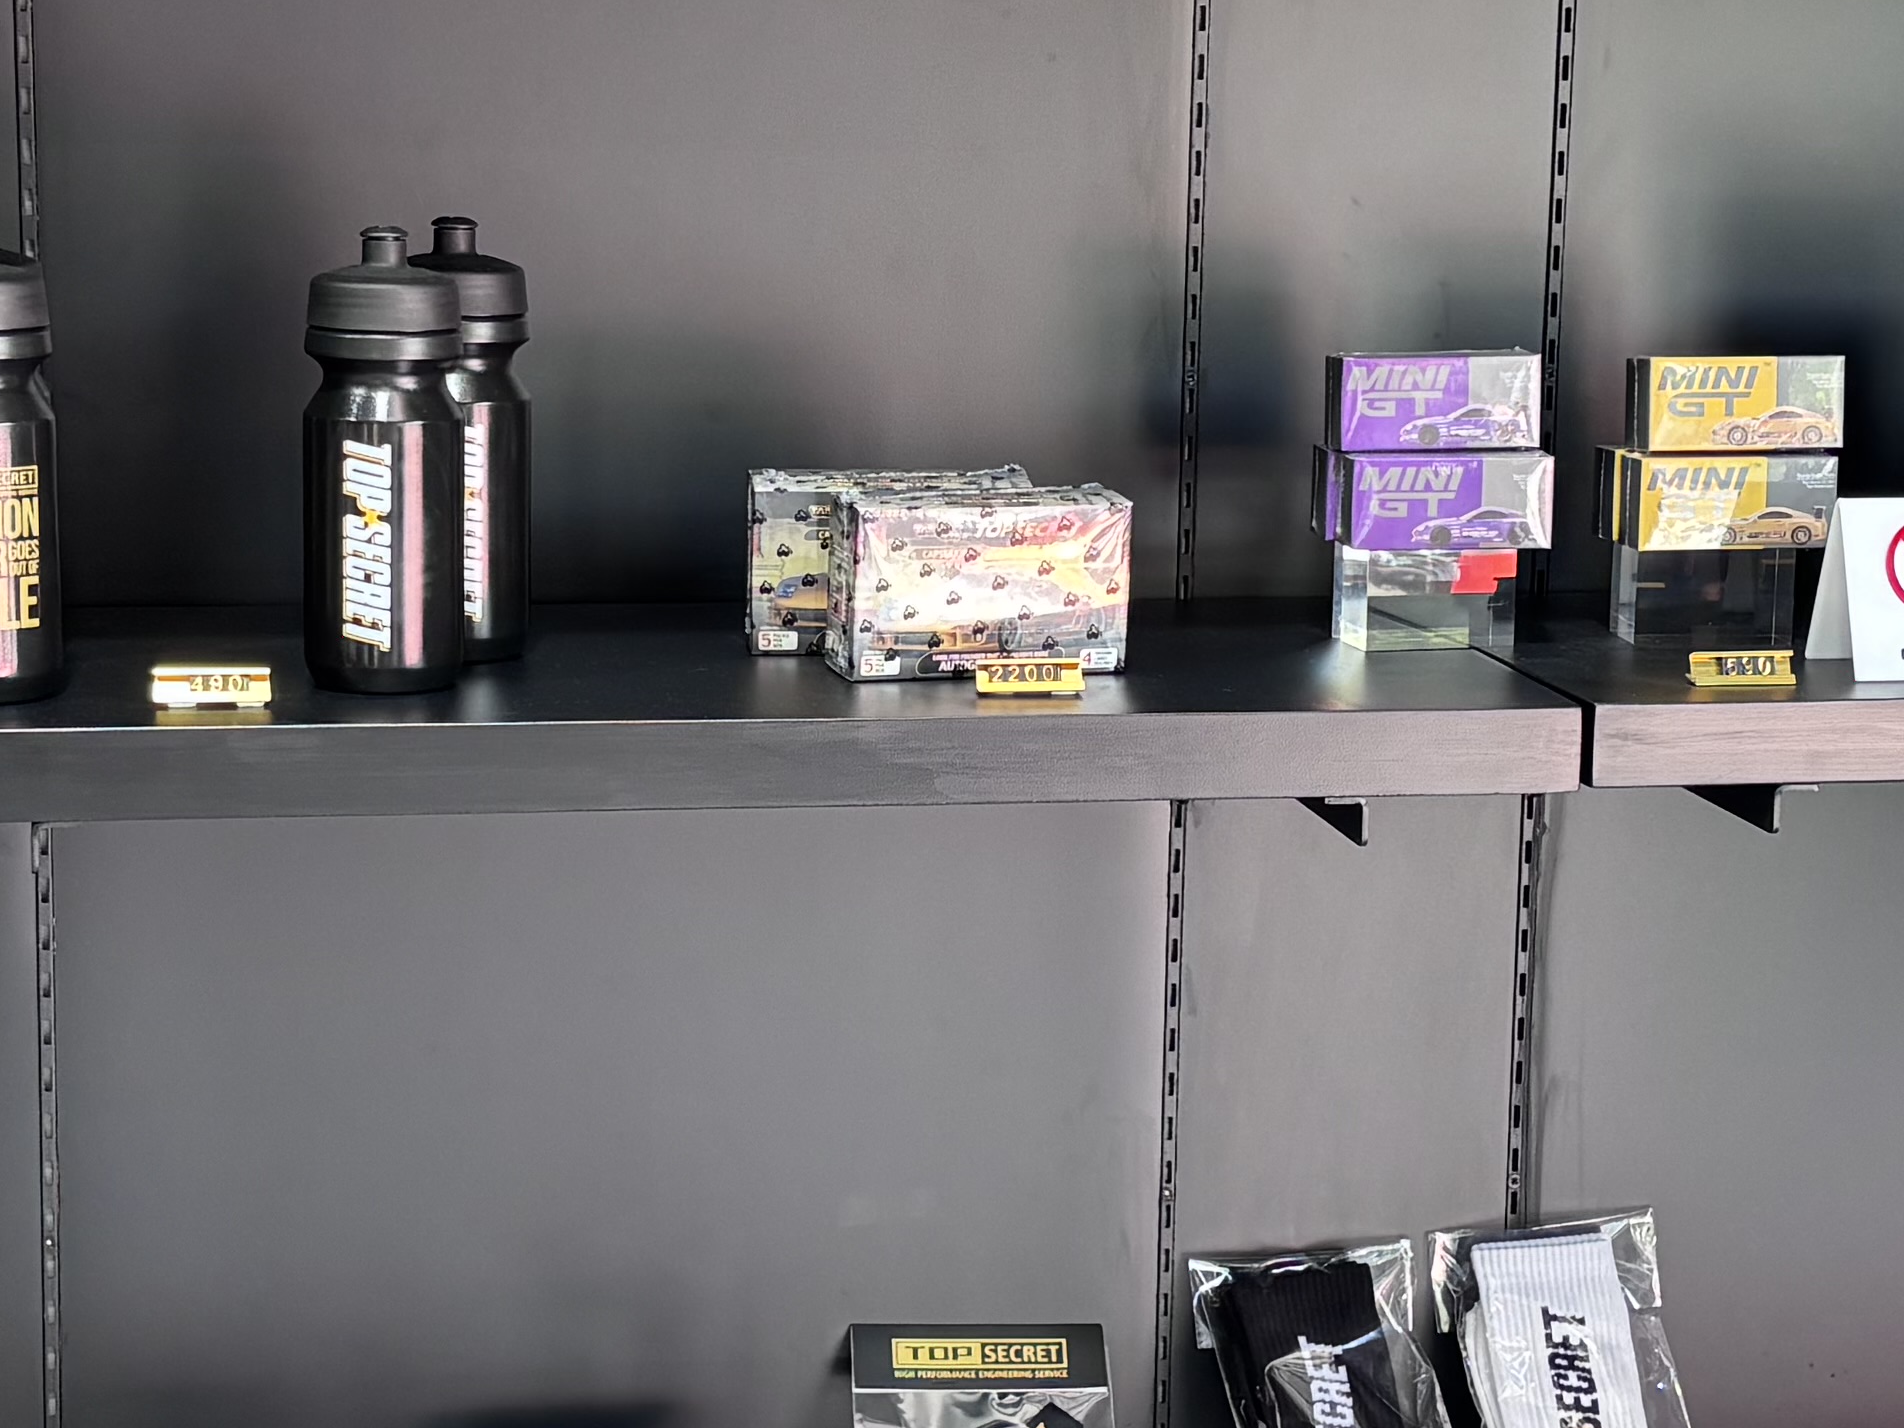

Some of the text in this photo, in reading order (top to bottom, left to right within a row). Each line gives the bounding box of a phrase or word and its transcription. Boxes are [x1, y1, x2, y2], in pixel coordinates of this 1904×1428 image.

[1347, 364, 1451, 391] MINI
[1657, 365, 1760, 391] MINI
[1360, 390, 1444, 417] GT
[1667, 390, 1752, 418] GT
[1358, 465, 1465, 492] MINI
[1647, 465, 1750, 492] MINI
[1371, 491, 1458, 518] GT
[9, 539, 40, 560] GOES
[11, 560, 40, 575] OUT OF
[343, 513, 392, 653] SECRET
[991, 665, 1055, 683] 2200
[905, 1344, 1060, 1363] TOP SECRET
